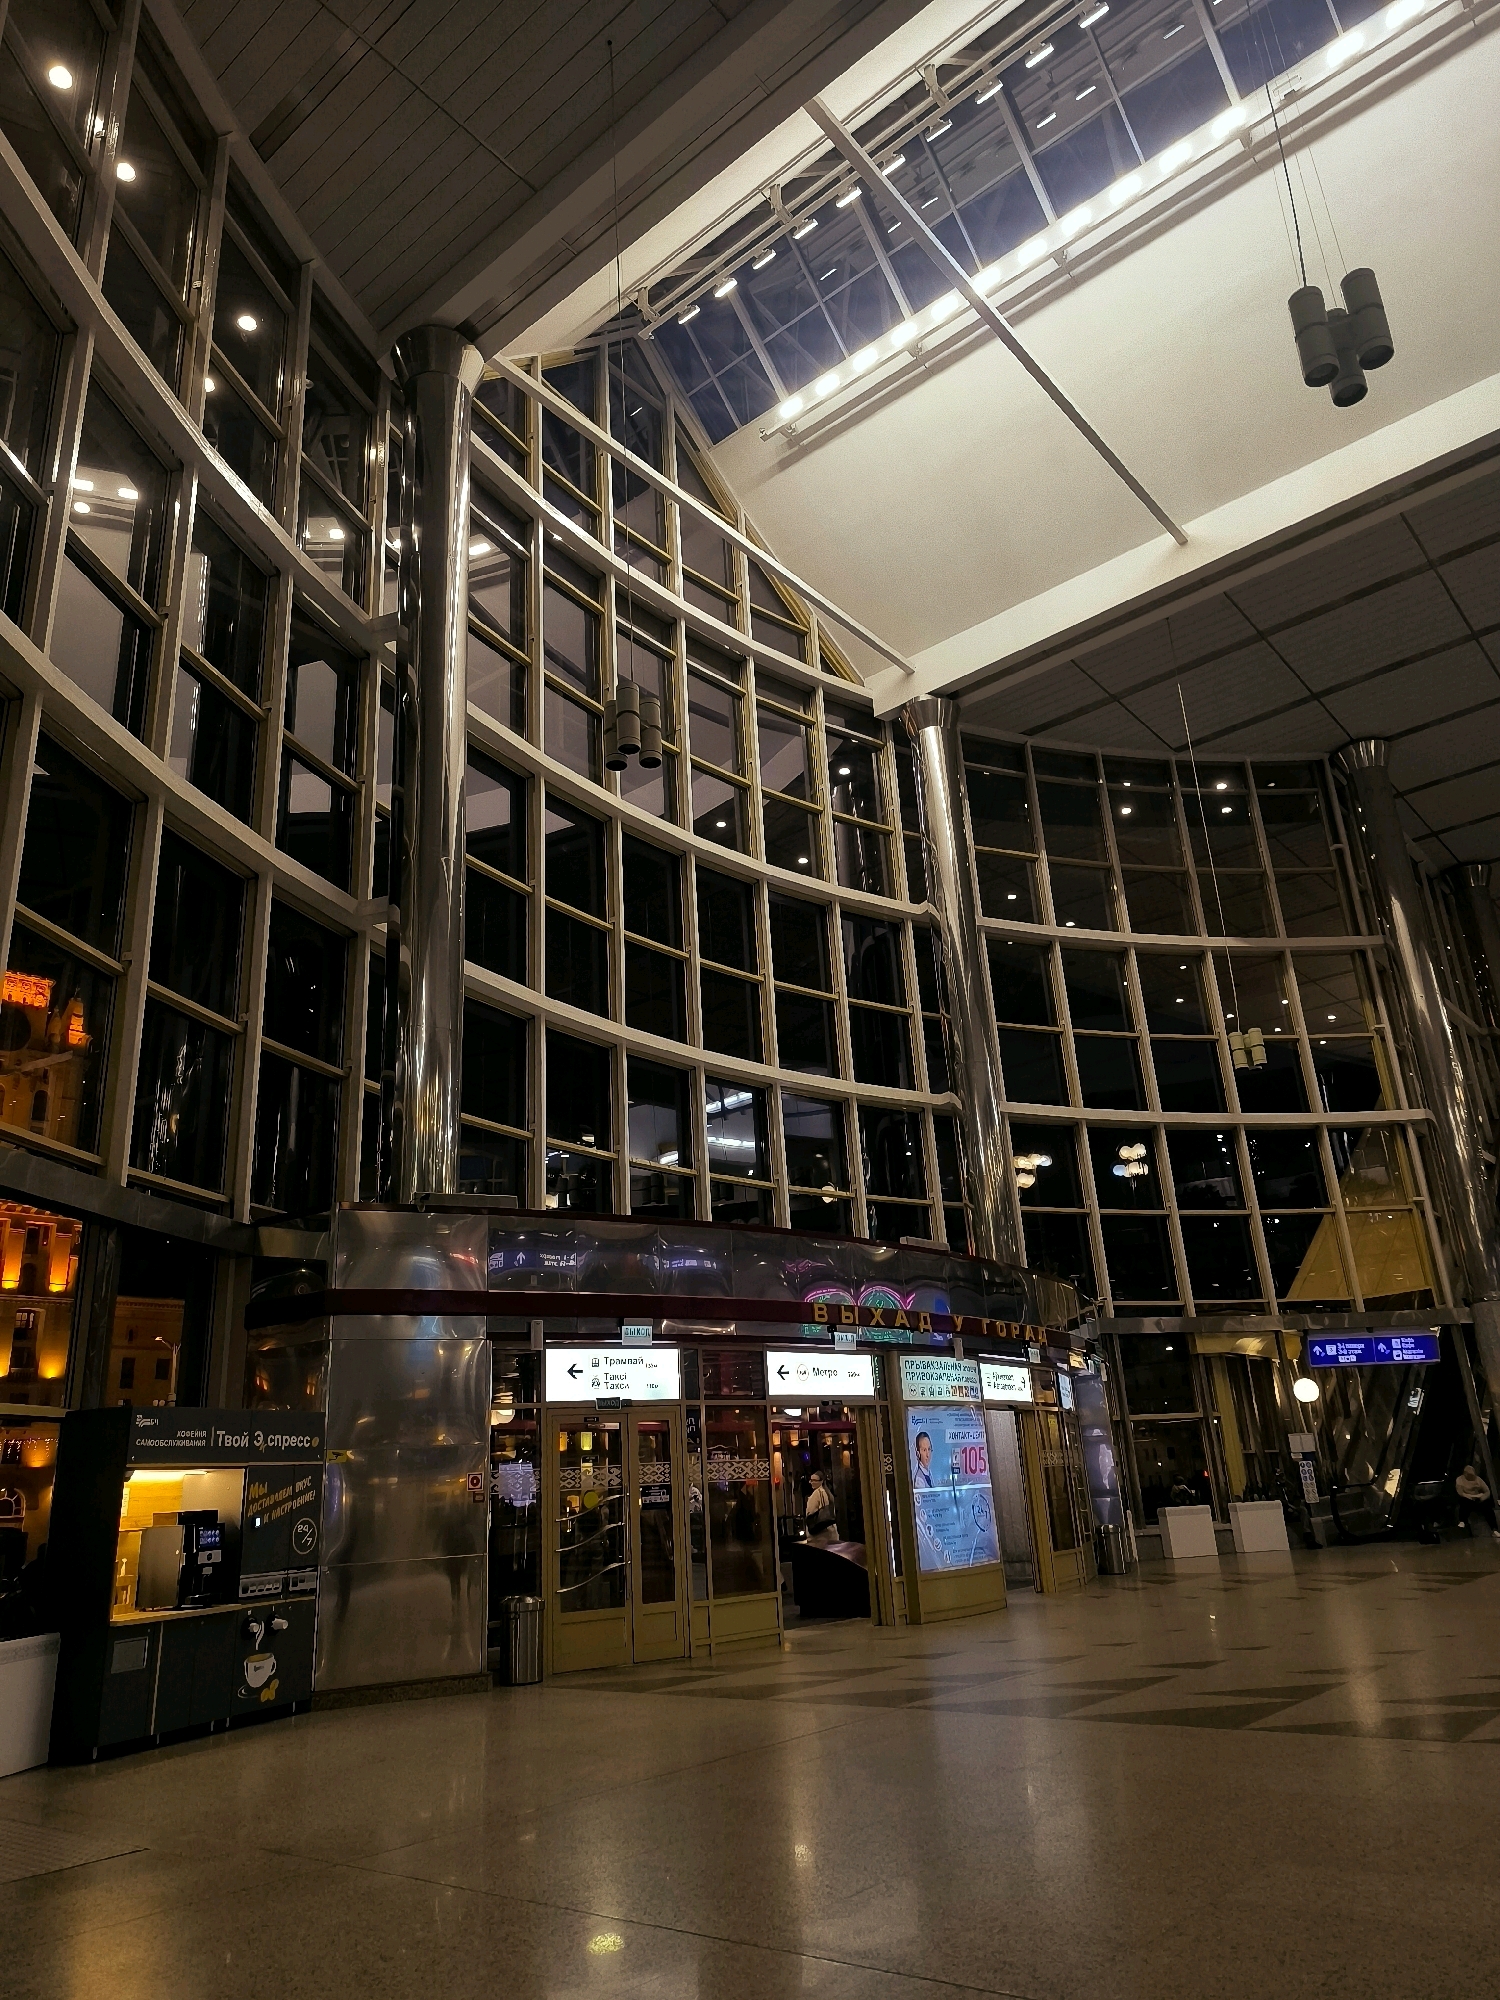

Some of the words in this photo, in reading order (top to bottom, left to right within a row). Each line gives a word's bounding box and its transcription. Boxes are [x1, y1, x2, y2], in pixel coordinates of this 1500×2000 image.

[813, 1302, 933, 1333] ВЫХАД
[952, 1315, 963, 1332] У
[982, 1318, 1048, 1345] ГОРАД
[624, 1327, 651, 1337] ВЫХОД
[603, 1355, 644, 1366] Трамвай
[812, 1367, 838, 1378] Метро
[177, 1429, 207, 1438] КОФЕЙНЯ
[217, 1430, 250, 1448] Твой
[961, 1446, 986, 1475] 105
[248, 1481, 268, 1500] Мы
